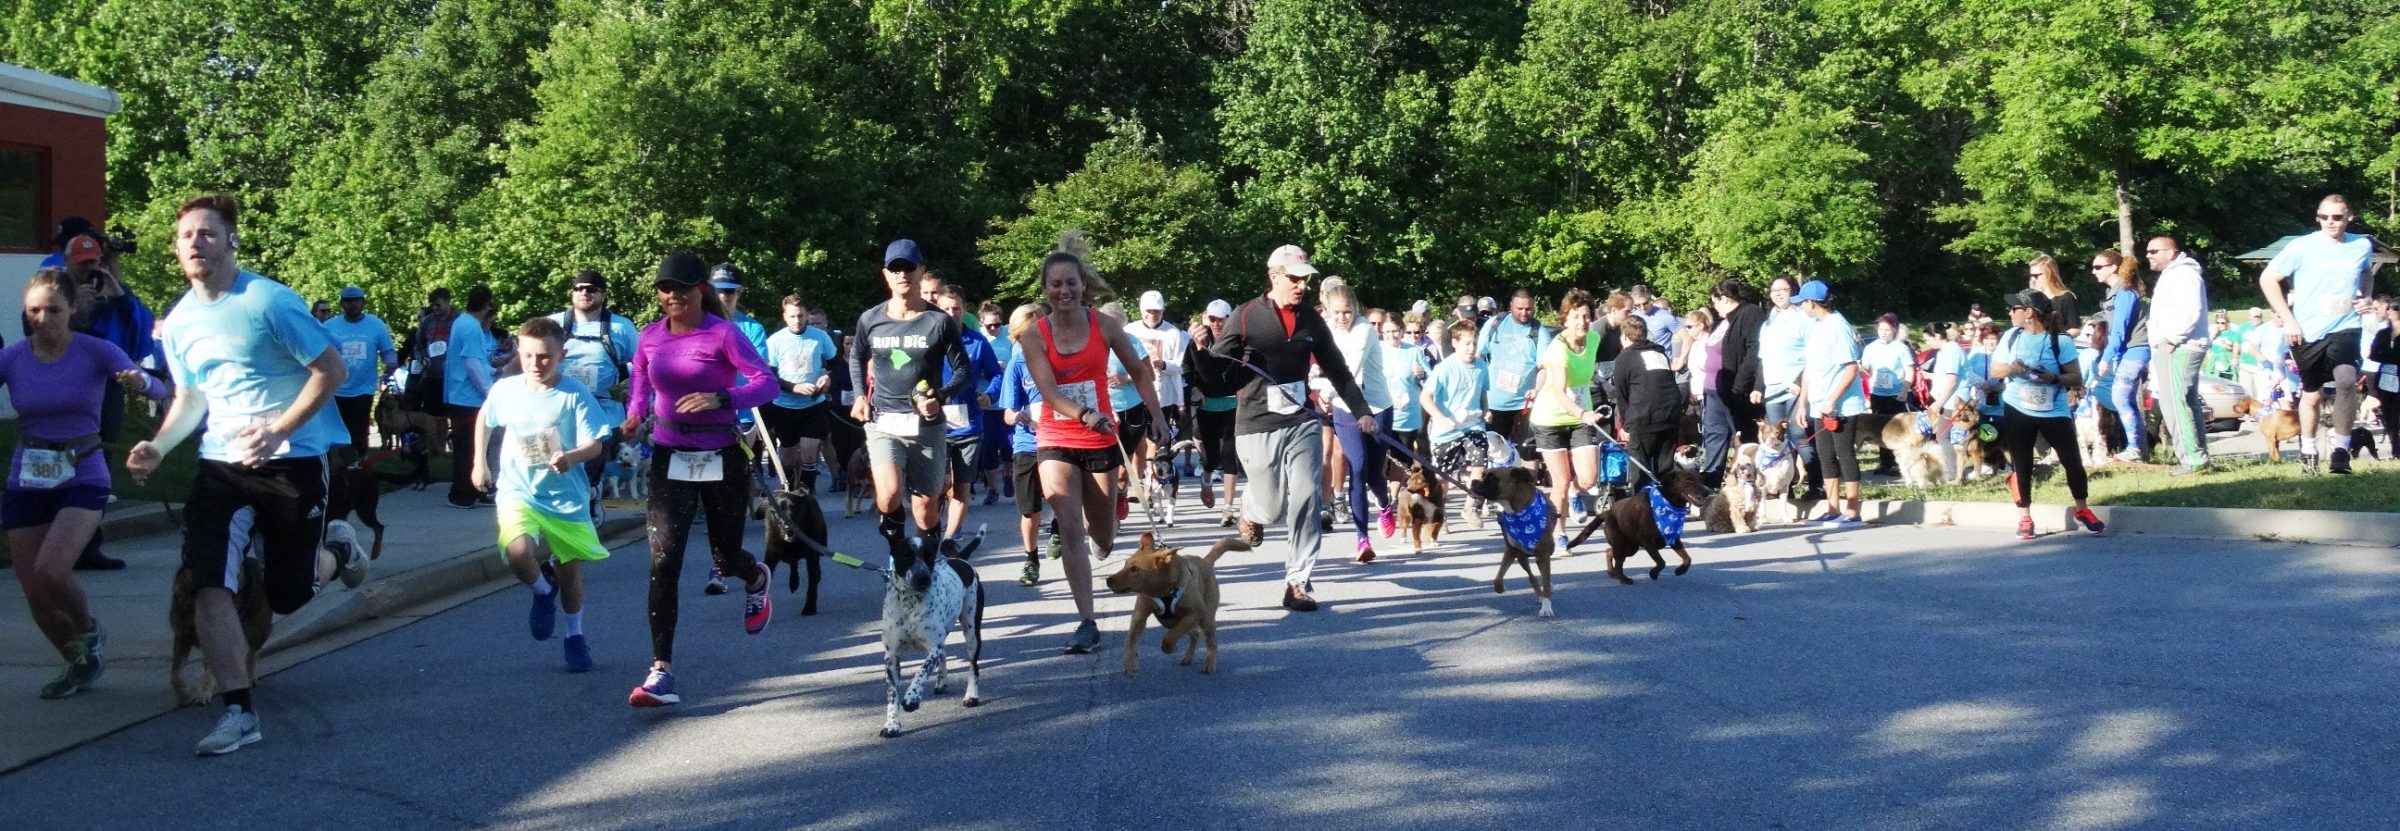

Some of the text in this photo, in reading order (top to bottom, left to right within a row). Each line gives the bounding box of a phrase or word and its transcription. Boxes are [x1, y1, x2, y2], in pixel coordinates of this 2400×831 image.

[872, 336, 900, 348] RUN
[32, 462, 62, 479] 380
[687, 463, 706, 479] 17
